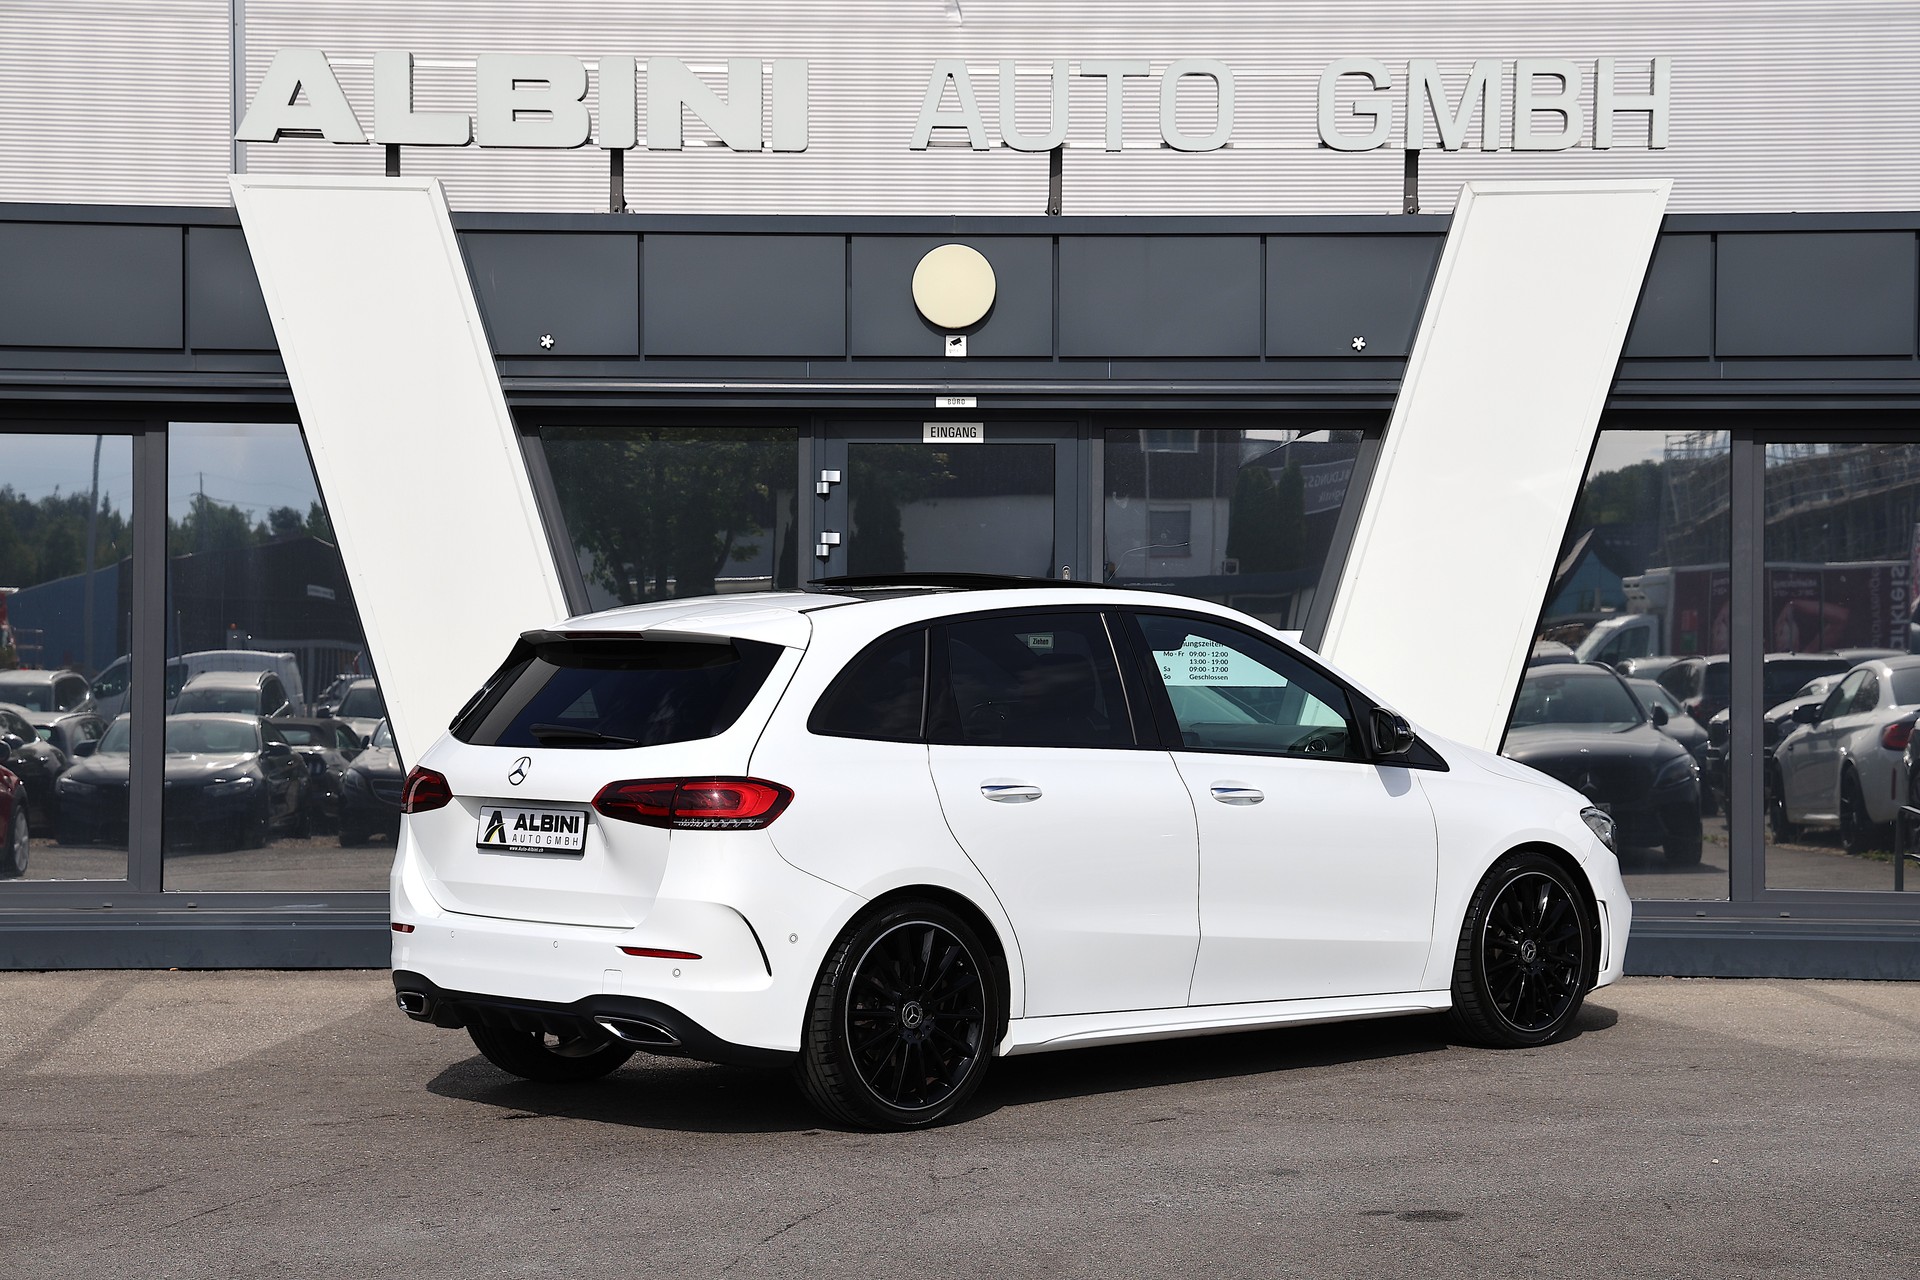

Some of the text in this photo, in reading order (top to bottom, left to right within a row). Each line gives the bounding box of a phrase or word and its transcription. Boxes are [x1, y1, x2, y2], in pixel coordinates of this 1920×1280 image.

[235, 49, 1673, 153] ALBINI AUTO GMBH
[930, 426, 977, 438] EINGANG
[513, 813, 580, 834] ALBINI
[511, 834, 579, 846] AUTO GMBH
